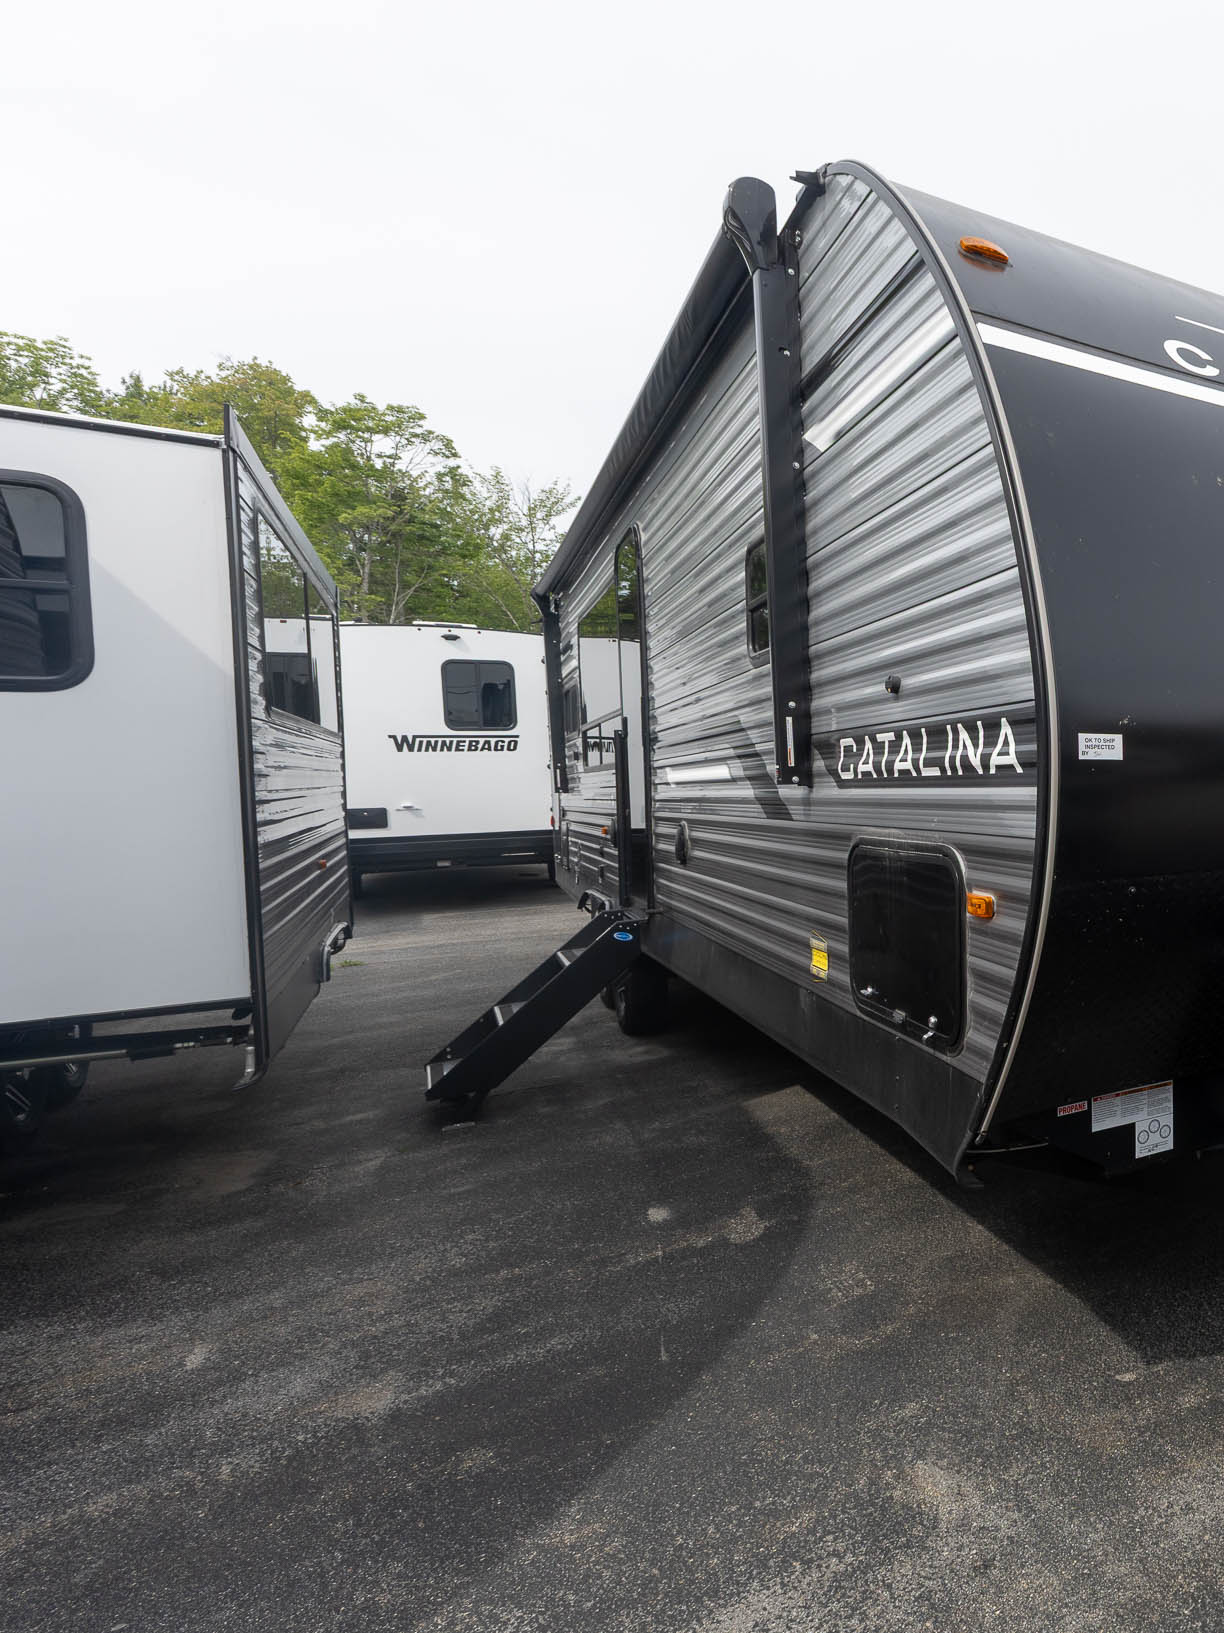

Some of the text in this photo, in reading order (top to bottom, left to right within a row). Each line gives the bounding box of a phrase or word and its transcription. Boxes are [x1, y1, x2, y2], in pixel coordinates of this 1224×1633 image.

[387, 734, 521, 753] WINNEBAGO
[837, 717, 1025, 780] CATALINA
[1058, 1102, 1087, 1115] PROPANE
